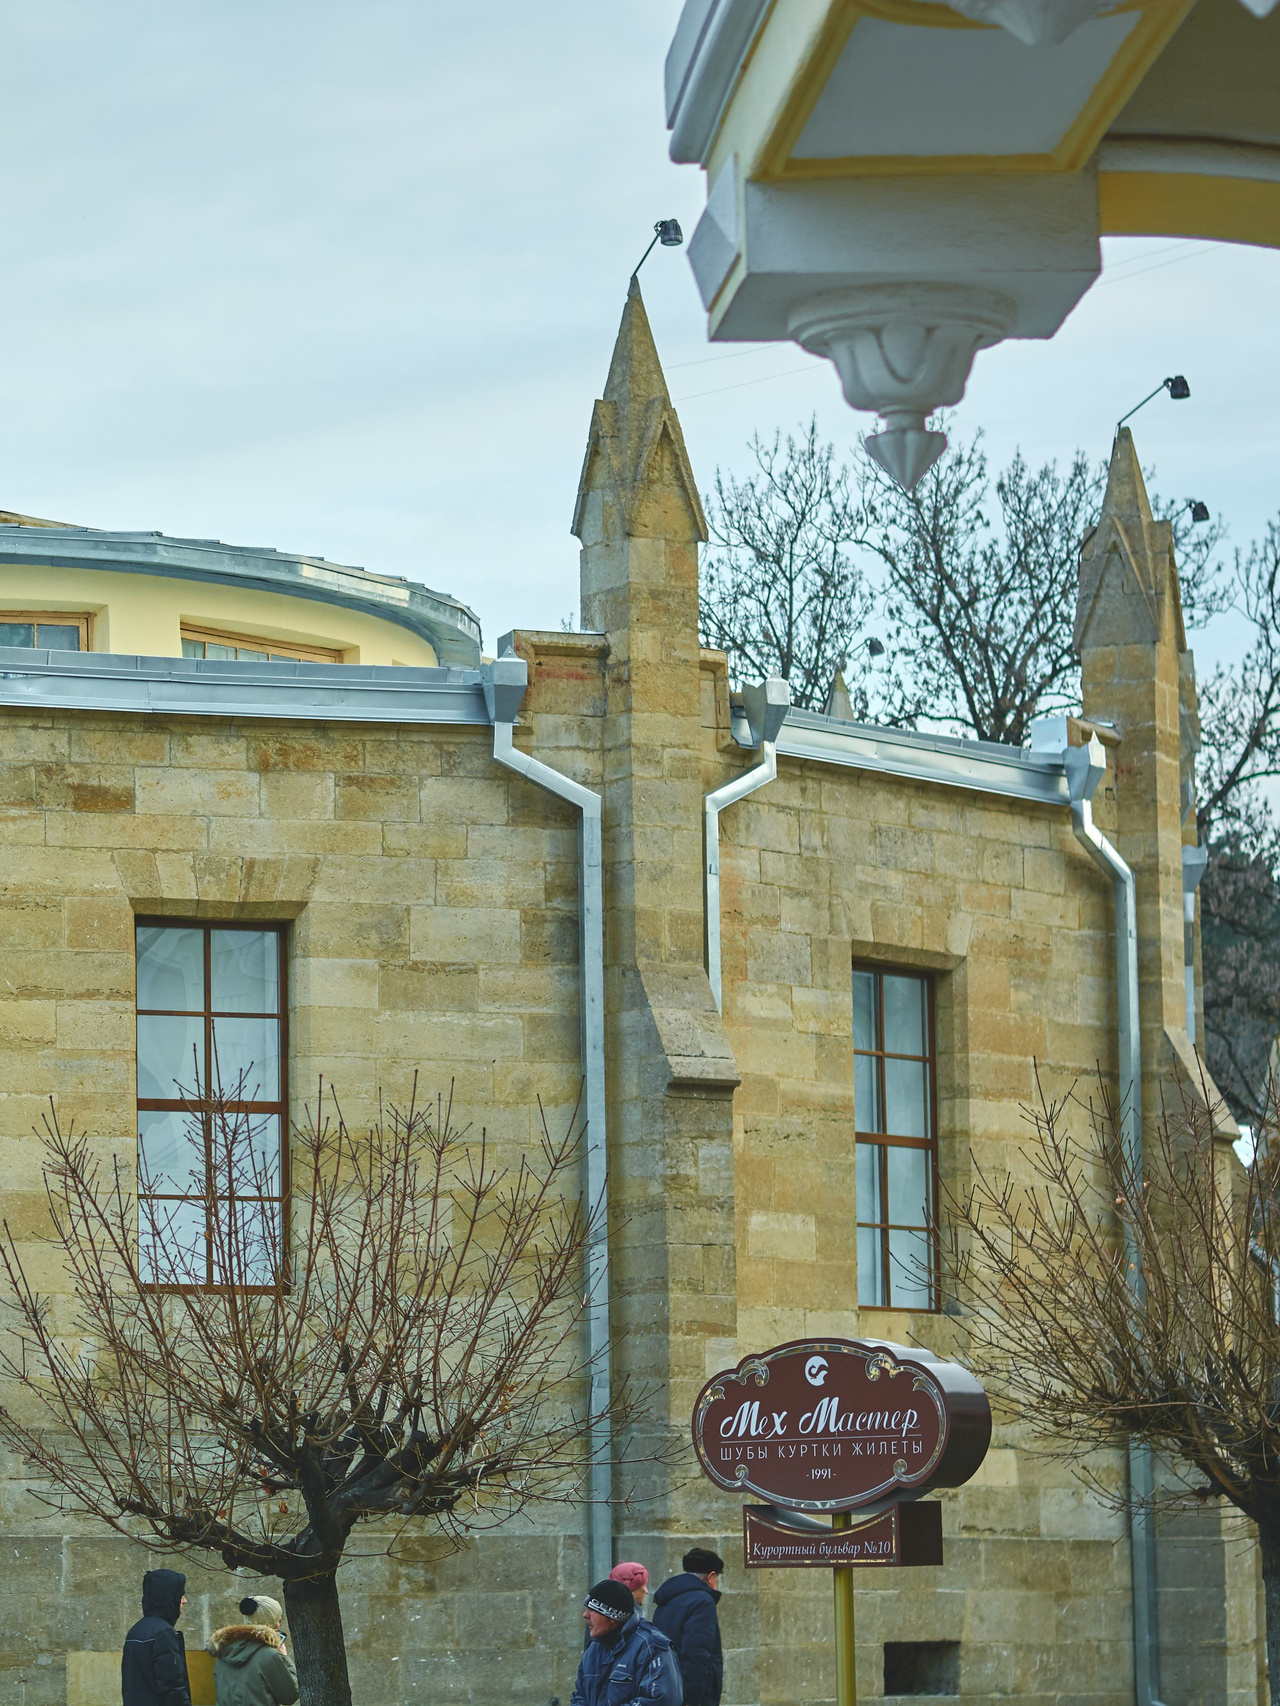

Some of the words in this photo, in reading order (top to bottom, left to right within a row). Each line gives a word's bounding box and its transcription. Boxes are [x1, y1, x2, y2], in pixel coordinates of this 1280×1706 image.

[720, 1400, 788, 1439] Мех
[798, 1396, 921, 1438] Мастер
[720, 1446, 768, 1461] ШУБЫ
[778, 1443, 842, 1458] КУРТКИ
[852, 1440, 923, 1456] ЖИЛЕТЫ
[753, 1542, 816, 1559] Курортный
[819, 1541, 861, 1557] бульвар
